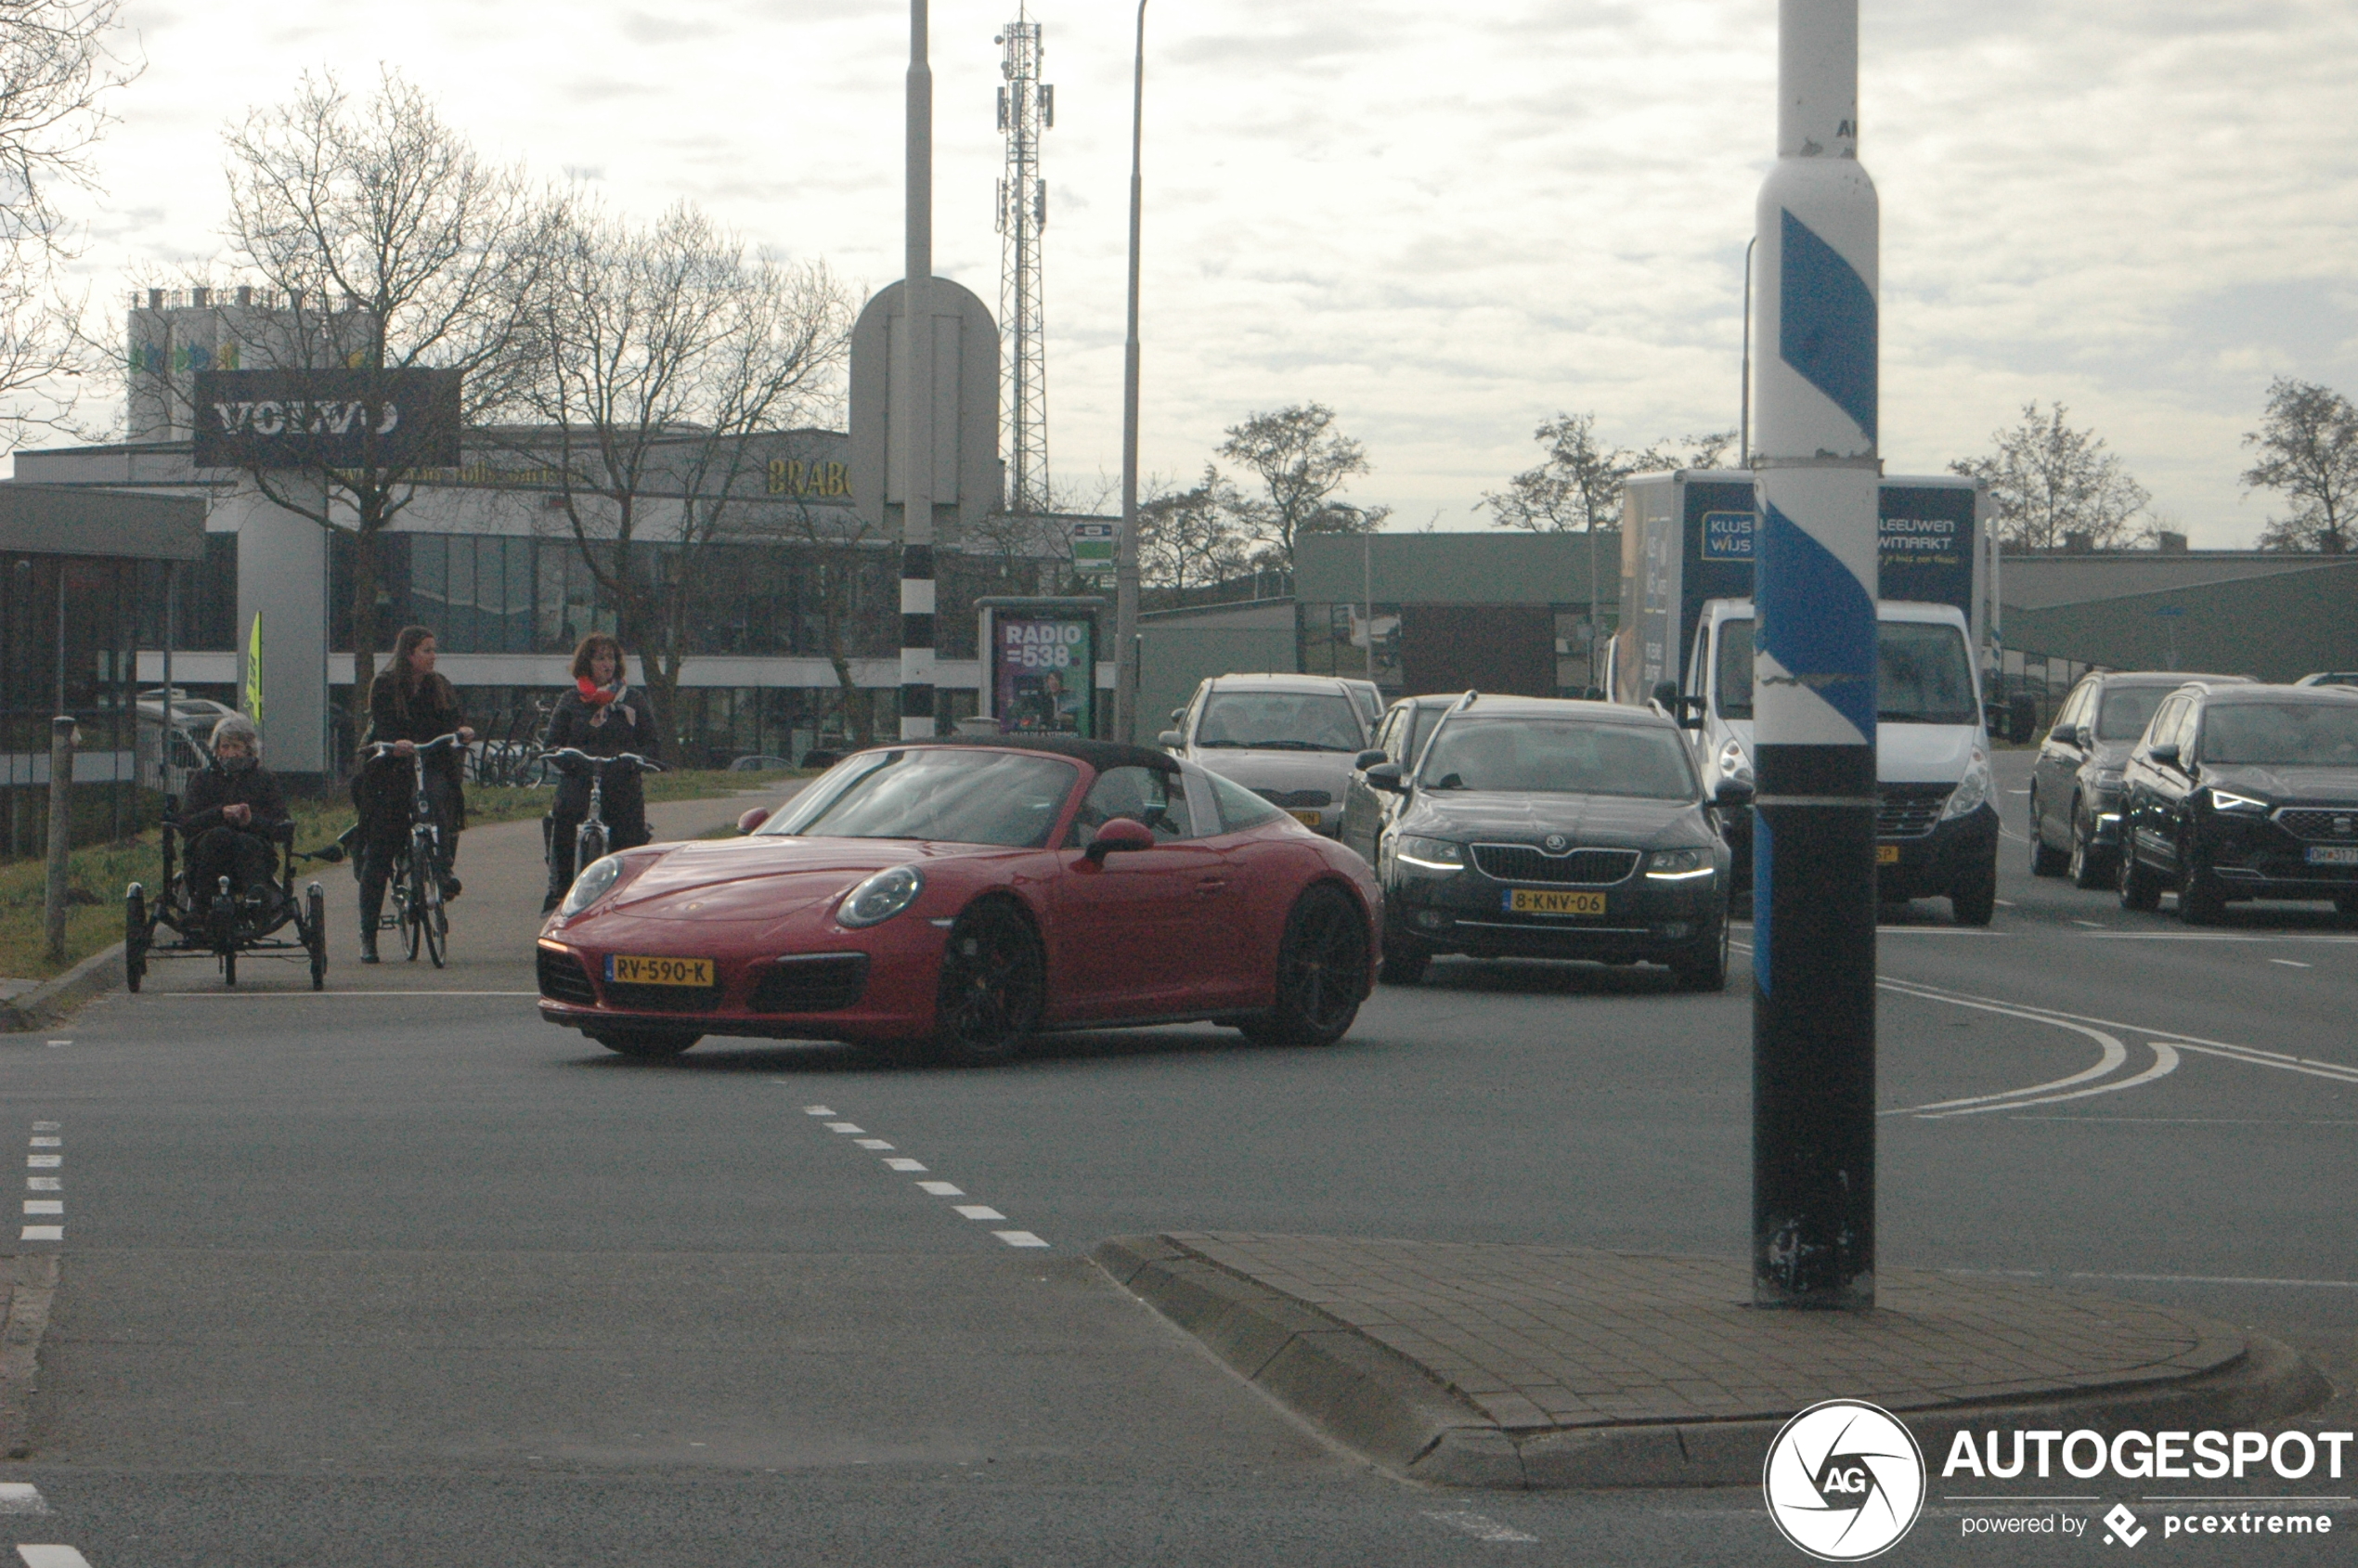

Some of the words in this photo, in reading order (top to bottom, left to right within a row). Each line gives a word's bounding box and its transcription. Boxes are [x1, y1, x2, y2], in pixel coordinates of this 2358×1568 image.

[214, 400, 398, 435] VOLVO
[1710, 521, 1752, 534] KLUS
[1879, 519, 1955, 533] LEEUWEN
[1710, 535, 1752, 552] WIJS
[1005, 625, 1081, 644] RADIO
[1515, 893, 1601, 912] 8-KNV-06
[616, 958, 706, 983] RV-590-K
